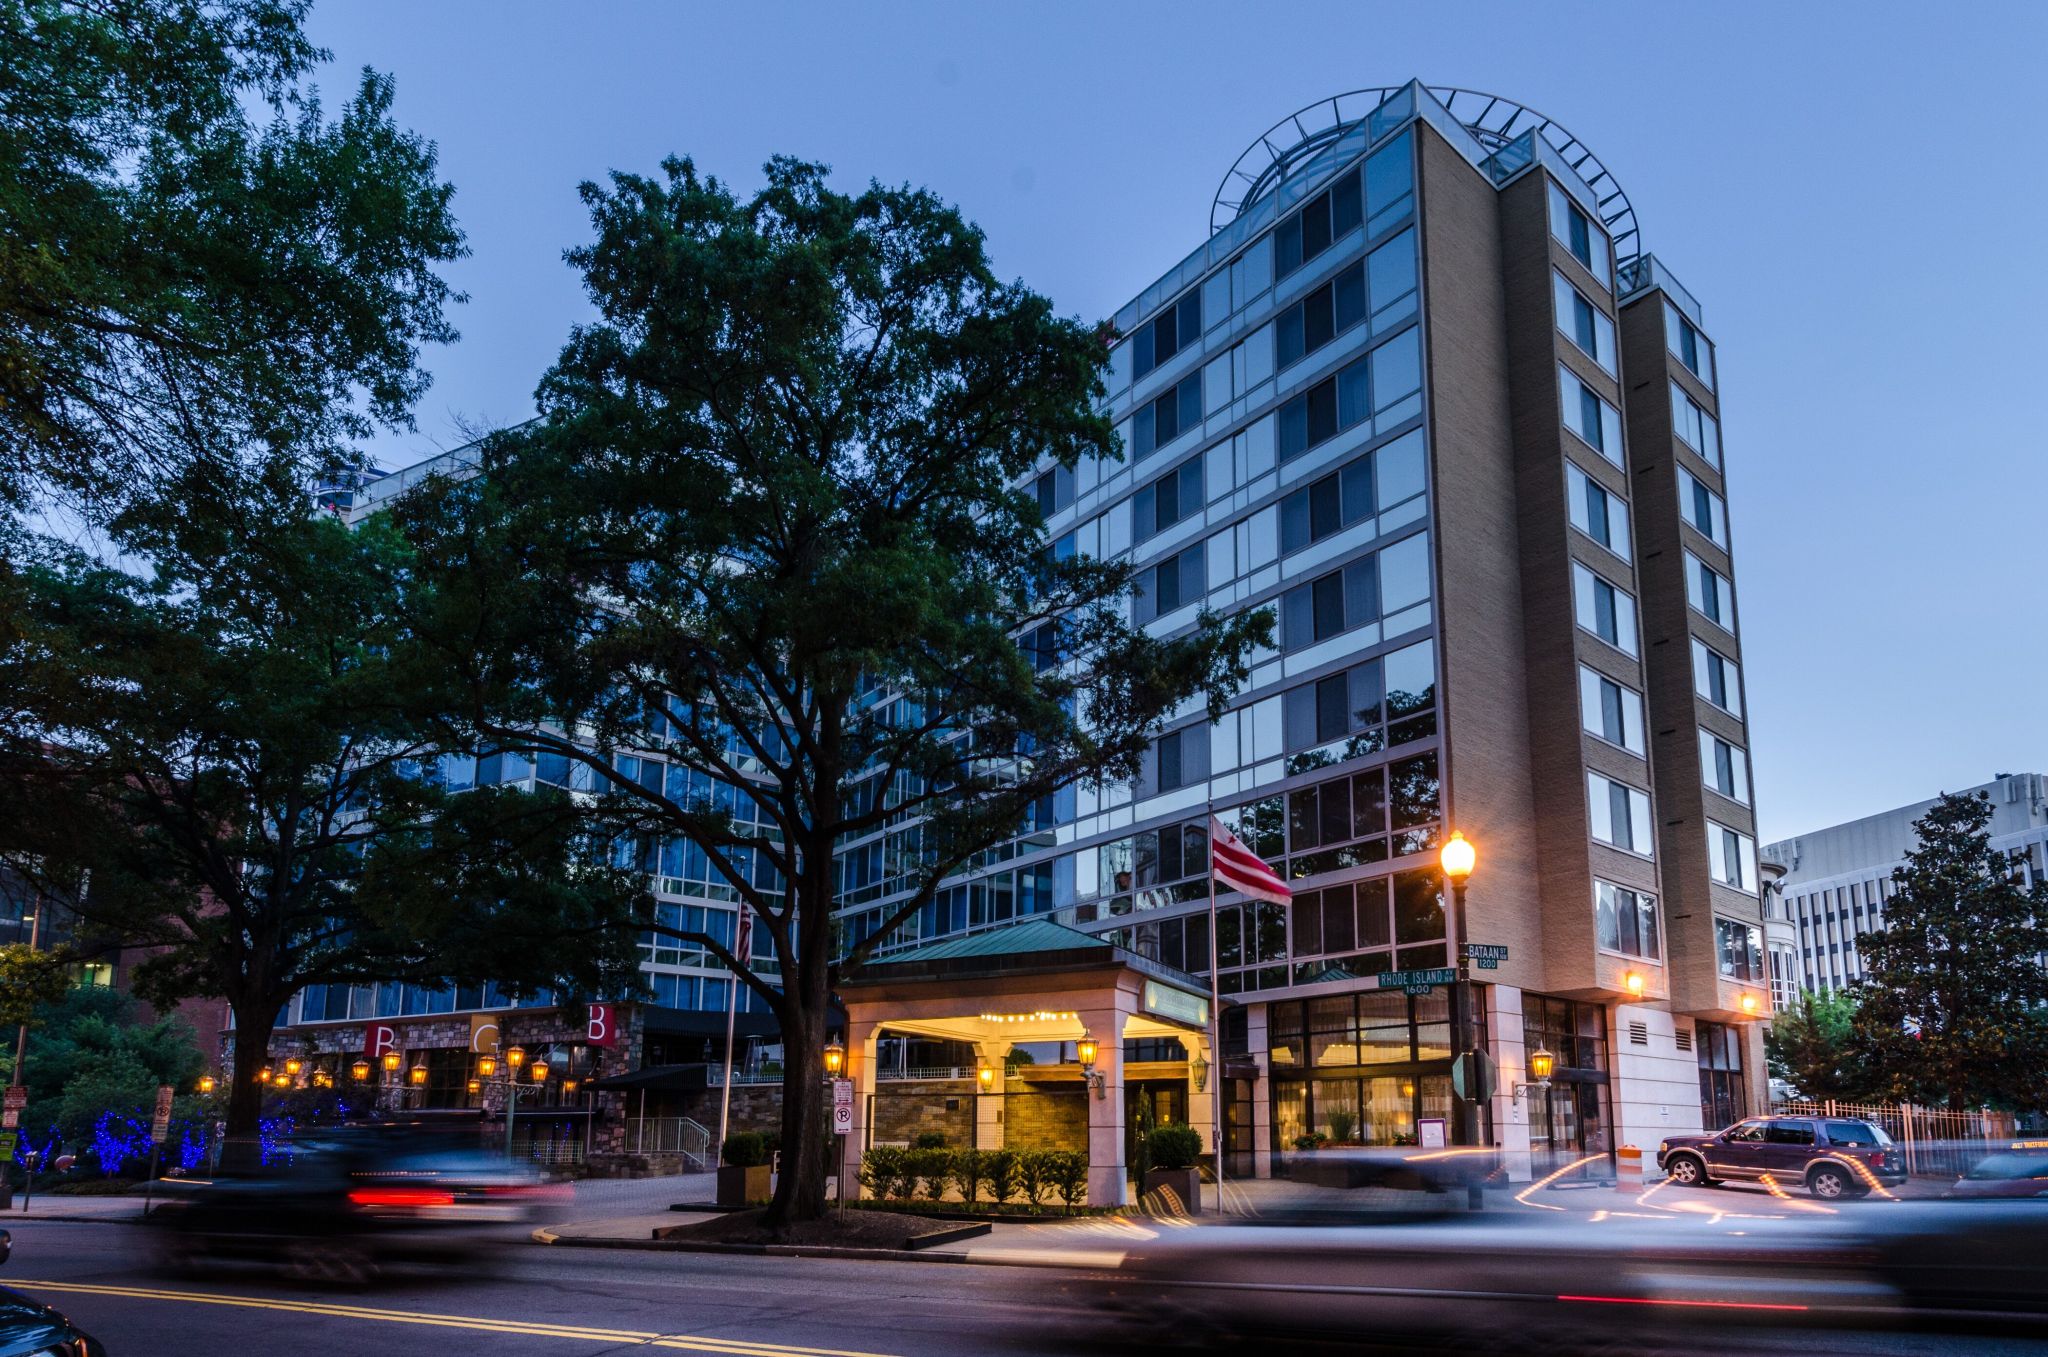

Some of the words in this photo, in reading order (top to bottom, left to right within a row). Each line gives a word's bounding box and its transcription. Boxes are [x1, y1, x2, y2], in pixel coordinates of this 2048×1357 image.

[1468, 945, 1499, 959] BATAAN
[1479, 959, 1496, 968] 1200
[1381, 973, 1408, 986] RHODE
[1412, 970, 1442, 984] ISLAND
[1406, 984, 1429, 994] 1600
[588, 1005, 606, 1040] B
[473, 1024, 499, 1053] G
